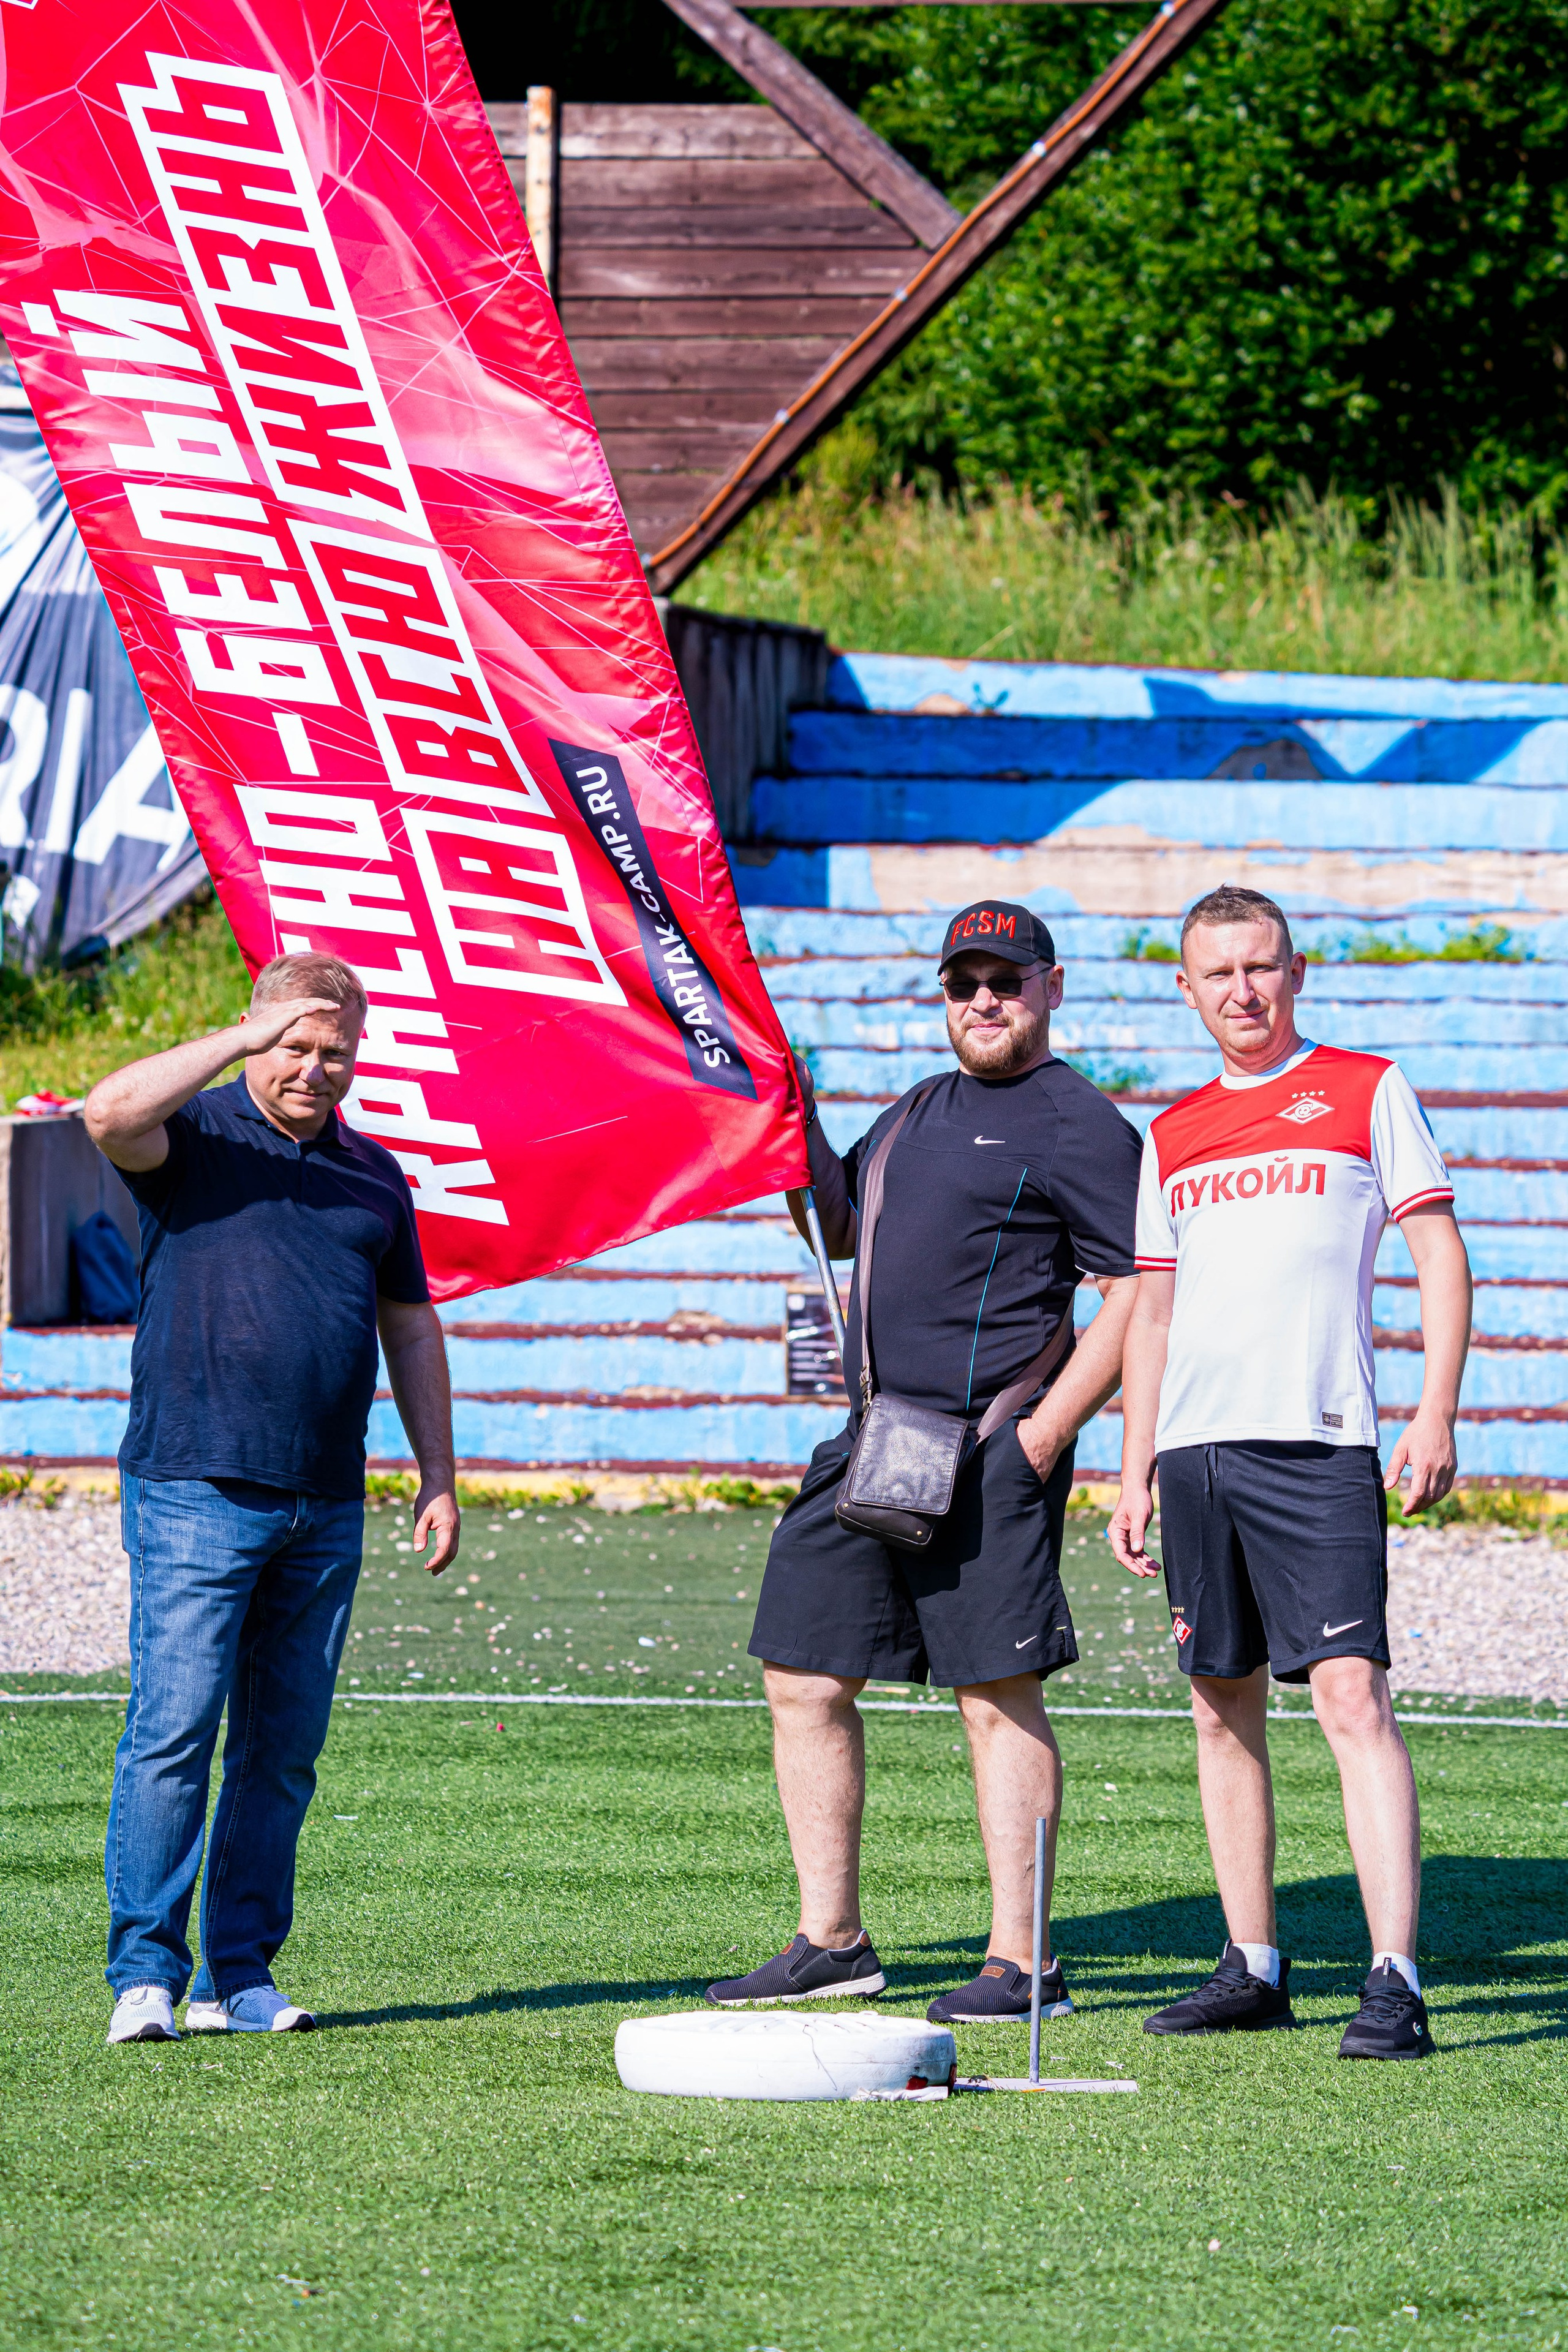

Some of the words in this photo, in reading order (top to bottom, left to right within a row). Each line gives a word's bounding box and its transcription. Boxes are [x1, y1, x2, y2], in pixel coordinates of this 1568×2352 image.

[130, 64, 421, 528] ЖИЗНЬ
[299, 530, 541, 806] ВСЮ
[414, 820, 615, 995] НА
[576, 766, 731, 1068] SPARTAK-CAMP.RU
[950, 910, 1017, 947] FCSM
[1170, 1156, 1326, 1218] ЛУКОЙЛ
